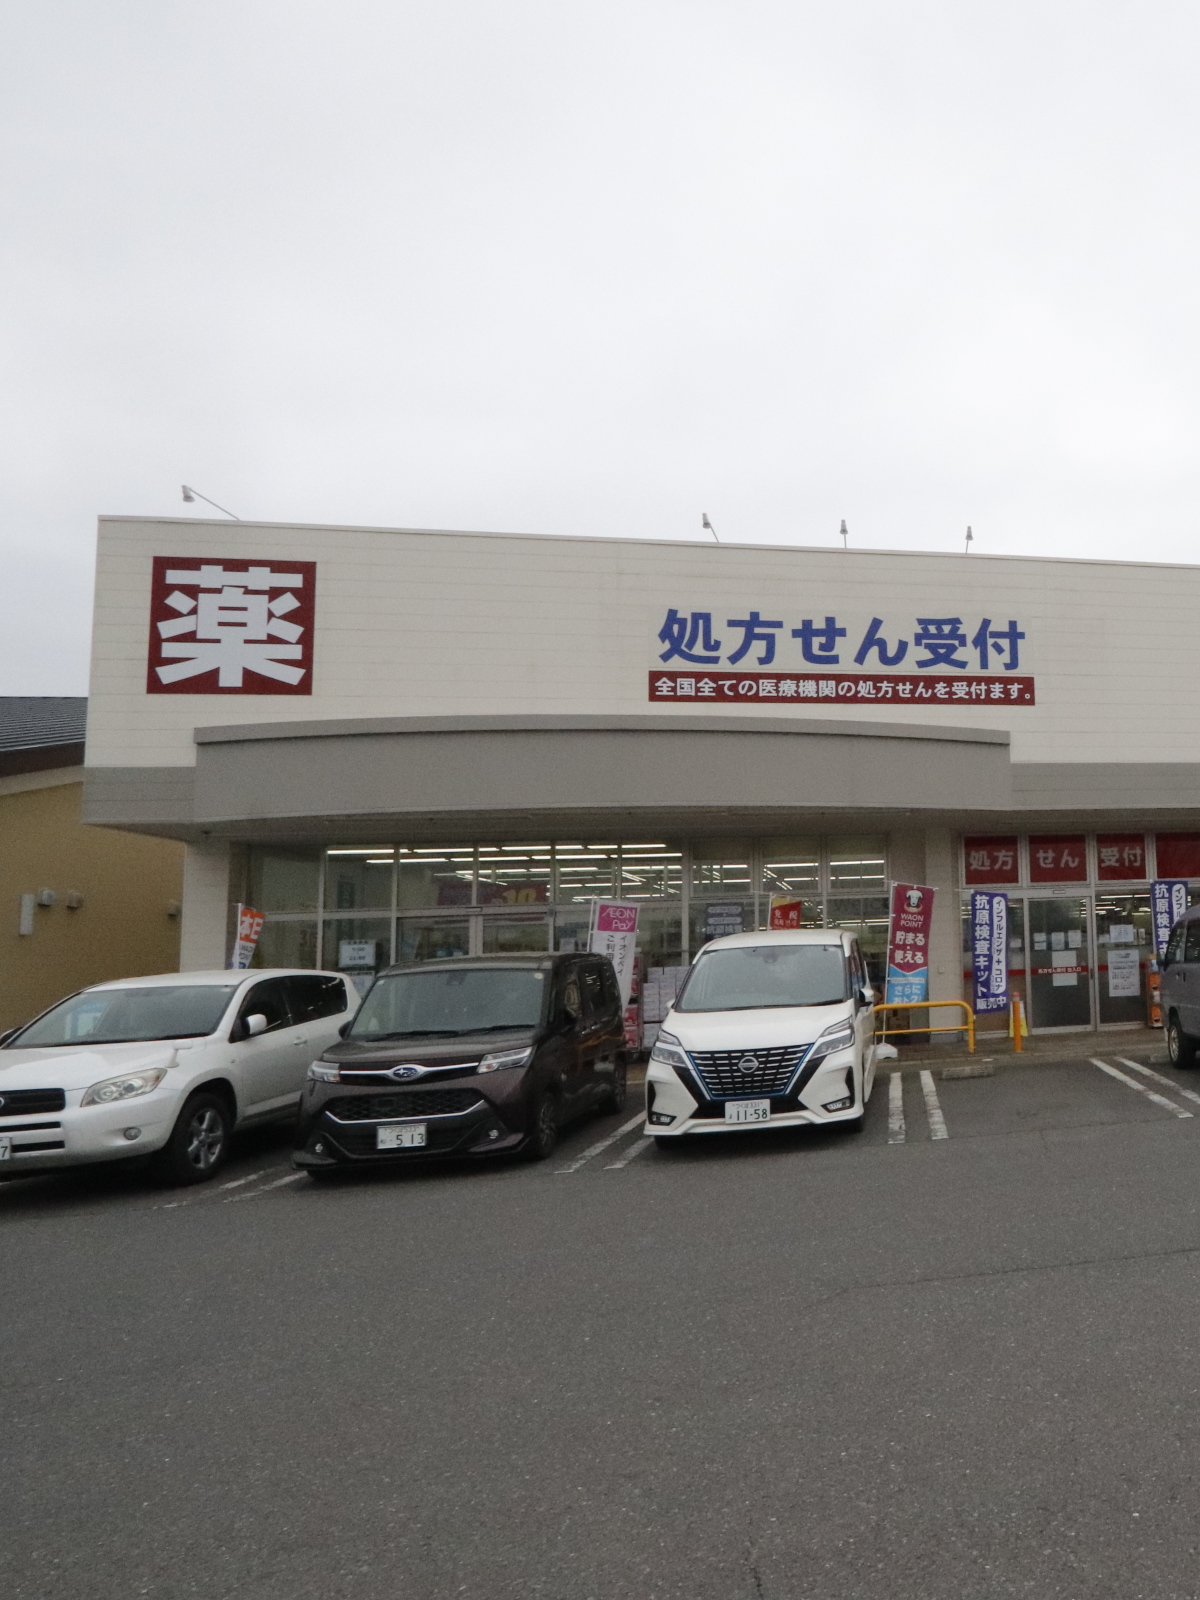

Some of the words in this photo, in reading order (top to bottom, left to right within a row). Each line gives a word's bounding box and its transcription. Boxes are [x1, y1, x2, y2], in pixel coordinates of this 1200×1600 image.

[155, 565, 306, 687] 薬
[658, 608, 1025, 671] 処方せん受付
[654, 676, 1031, 700] 全国全ての医療機関の処方せんを受付ます。
[969, 849, 1014, 871] 処方
[1036, 849, 1080, 868] せん
[1100, 847, 1142, 867] 受付
[900, 913, 924, 921] WAON
[900, 920, 922, 928] POINT
[895, 950, 924, 964] 使える
[975, 894, 990, 997] 抗原検査キット
[976, 995, 1007, 1010] 販売中
